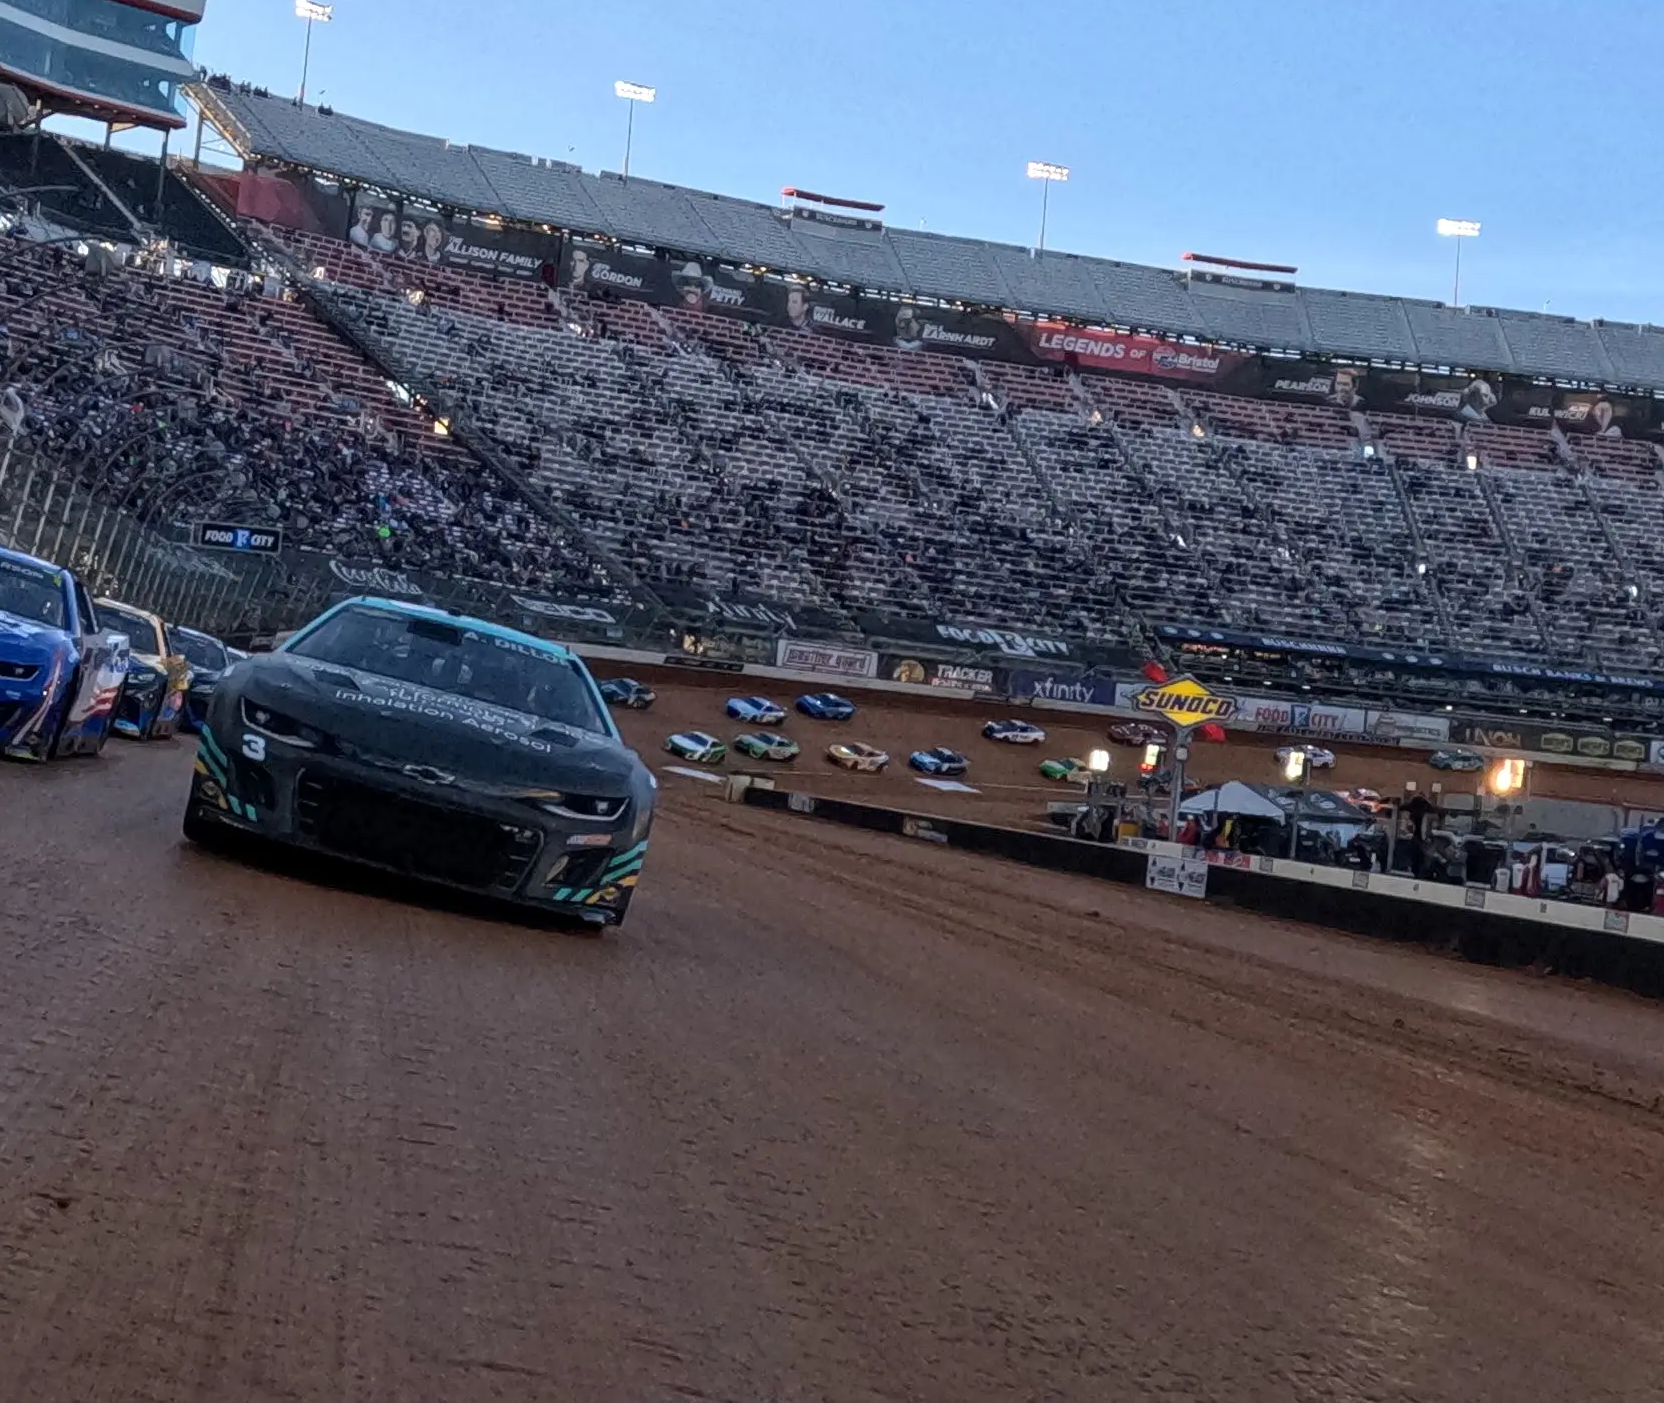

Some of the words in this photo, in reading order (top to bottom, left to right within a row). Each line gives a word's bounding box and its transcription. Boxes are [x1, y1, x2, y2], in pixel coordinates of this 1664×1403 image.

[445, 241, 499, 262] ALLISON
[500, 251, 543, 270] FAMILY
[593, 270, 643, 287] GORDON
[812, 312, 866, 331] WALLACE
[922, 330, 997, 348] EARNHARDT
[1039, 332, 1126, 359] LEGENDS
[1129, 348, 1146, 359] OF
[1177, 352, 1221, 370] Bristol
[1275, 379, 1331, 394] PEARSON
[204, 529, 235, 544] FOOD
[250, 534, 275, 548] CITY
[936, 664, 994, 682] TRACKER
[1033, 676, 1095, 704] xfinity
[1141, 690, 1234, 717] SUNOCO
[336, 689, 455, 721] Inhalation
[461, 717, 552, 754] Aerosol
[1255, 706, 1291, 723] FOOD
[1311, 712, 1338, 729] CITY
[242, 733, 266, 762] 3
